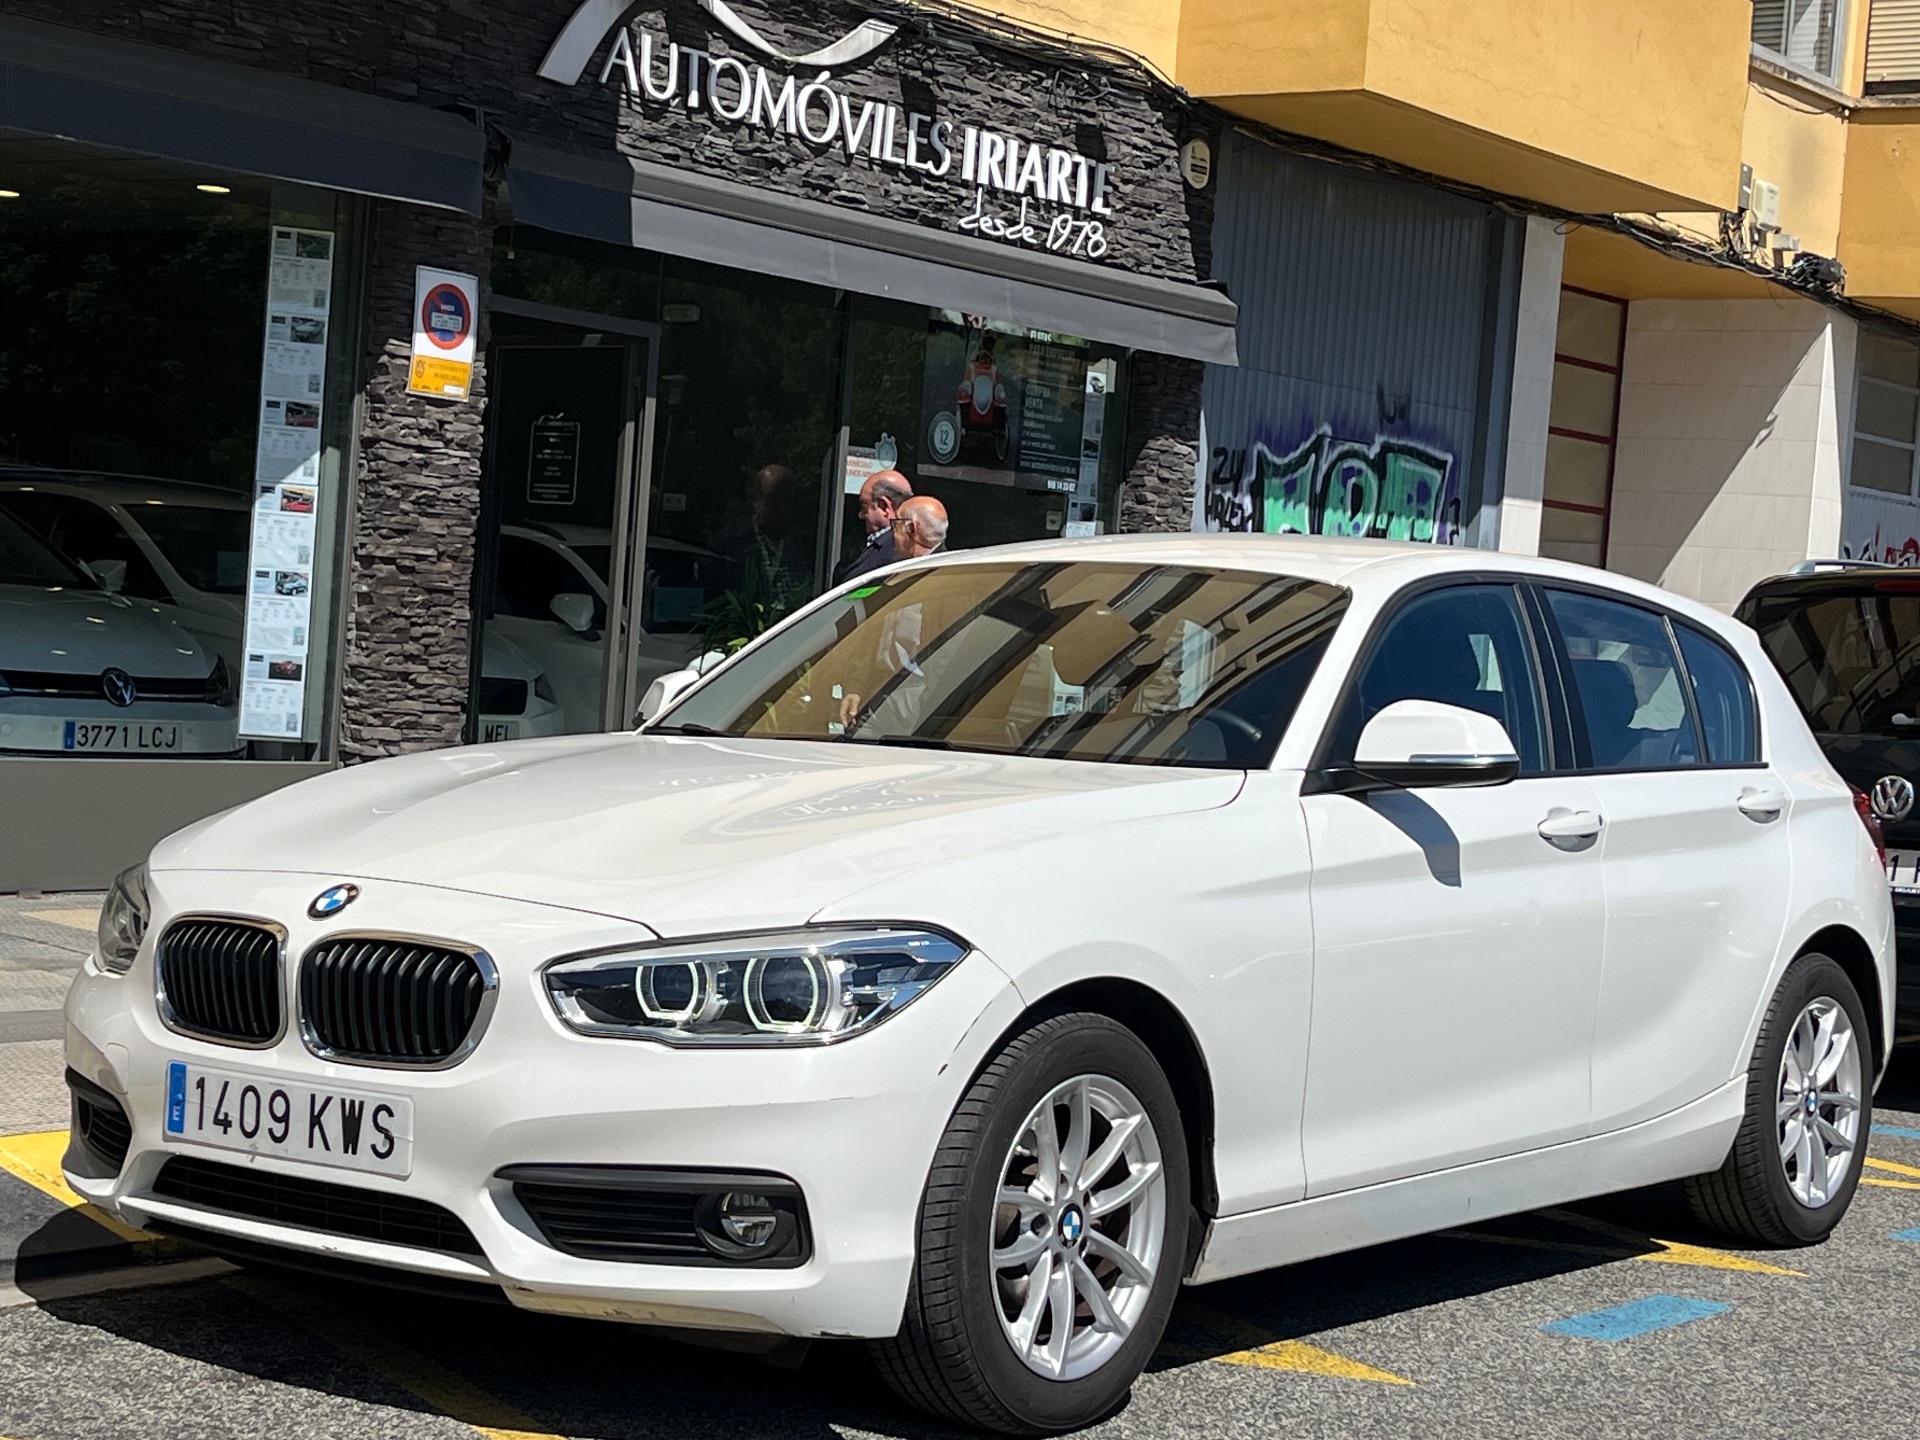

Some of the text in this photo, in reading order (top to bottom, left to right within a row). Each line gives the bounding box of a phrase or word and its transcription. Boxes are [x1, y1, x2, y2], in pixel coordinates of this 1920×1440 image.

[598, 26, 1116, 215] AUTOMÓVILES IRIARTE
[957, 187, 1107, 258] desde 1978
[77, 725, 129, 748] 3771
[138, 726, 177, 748] LCJ
[196, 1076, 291, 1144] 1409
[308, 1093, 395, 1160] KWS
